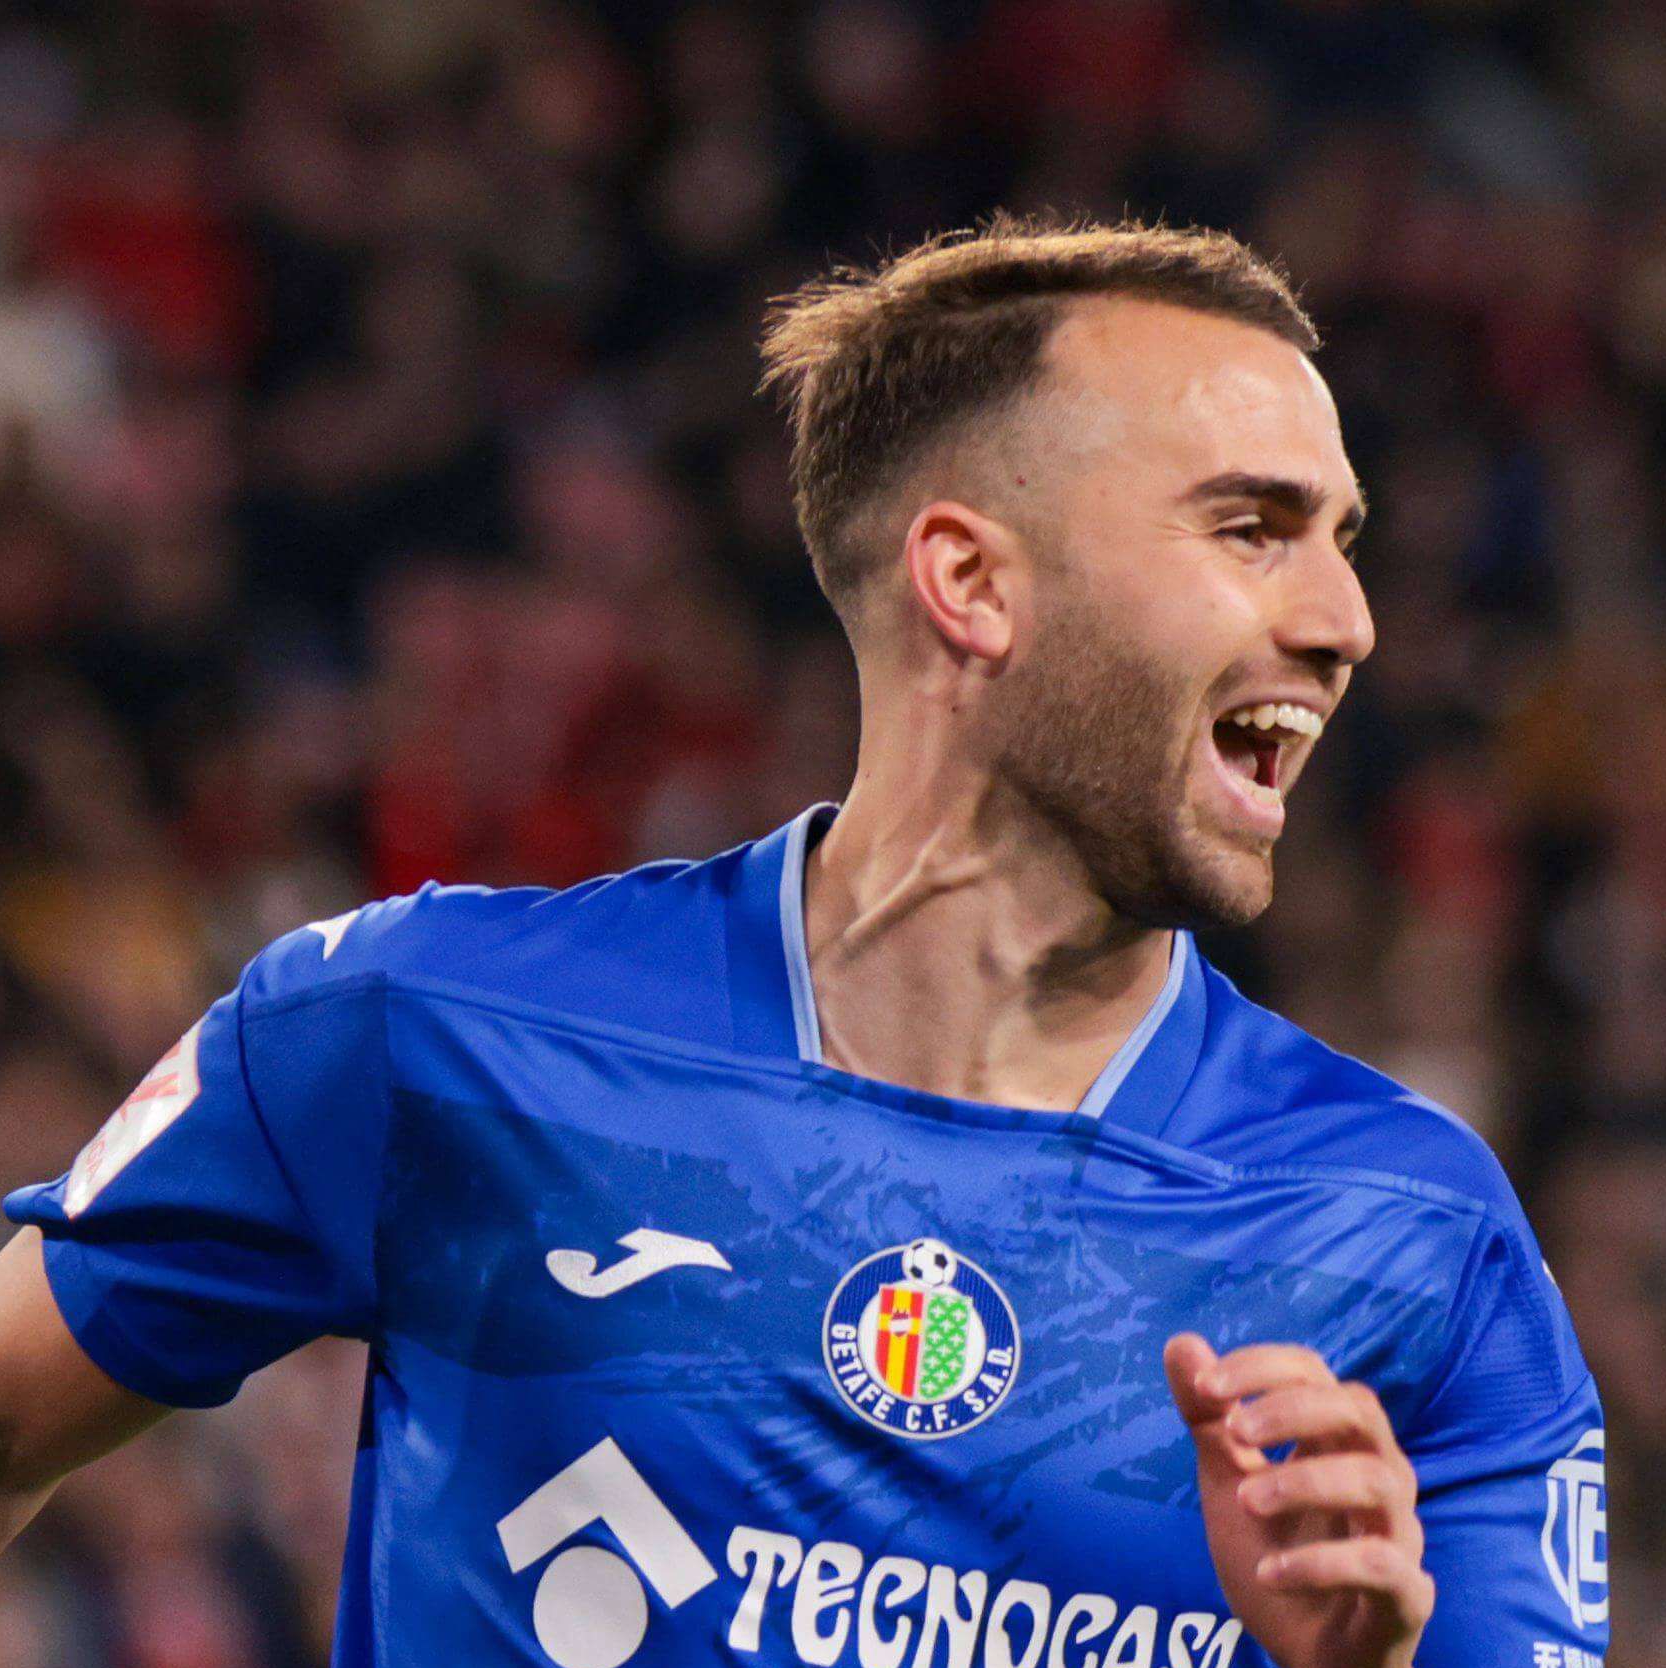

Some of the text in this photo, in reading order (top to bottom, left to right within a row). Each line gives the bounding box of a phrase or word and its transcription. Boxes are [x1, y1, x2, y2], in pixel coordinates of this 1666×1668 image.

[831, 1323, 1014, 1432] GETAFE C.F. S.A.D.
